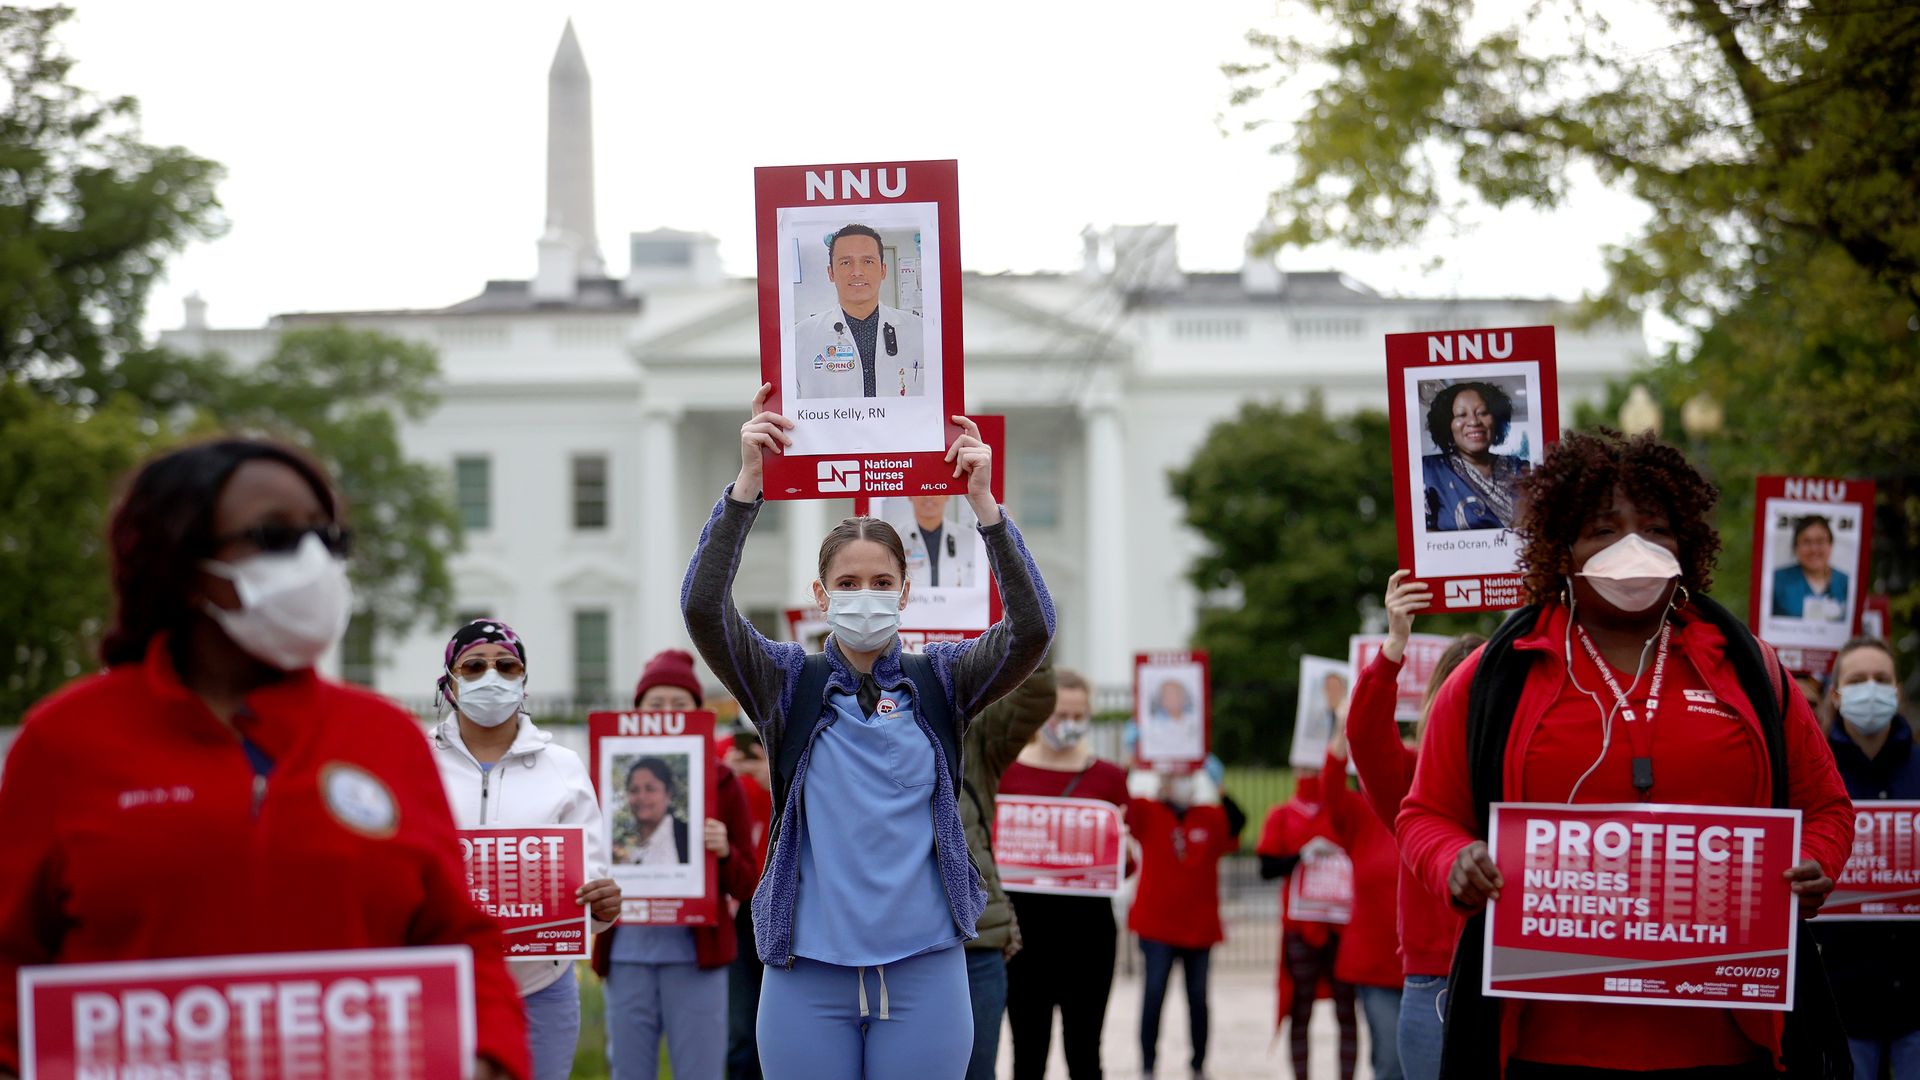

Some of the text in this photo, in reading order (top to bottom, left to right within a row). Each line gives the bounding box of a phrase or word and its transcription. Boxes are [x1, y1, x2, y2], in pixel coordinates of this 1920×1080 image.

[805, 167, 907, 200] NNU
[1427, 332, 1513, 362] NNU
[797, 407, 885, 421] Kious Kelly, RN
[864, 458, 913, 469] National
[865, 471, 904, 480] Nurses
[865, 481, 904, 491] United
[1784, 478, 1847, 502] NNU
[1427, 537, 1508, 551] Freda Ocran, RN
[1484, 576, 1524, 588] National
[1484, 587, 1518, 597] Nurses
[1484, 596, 1517, 607] United
[618, 713, 686, 735] NNU
[998, 803, 1109, 828] PROTECT
[1525, 818, 1766, 863] PROTECT
[458, 836, 565, 862] OTECT
[1846, 855, 1888, 869] ENTS
[1523, 869, 1629, 892] NURSES
[1841, 870, 1920, 884] LIC HEALT
[483, 903, 544, 917] EALTH
[1522, 893, 1650, 917] PATIENTS
[536, 930, 581, 939] #COVID19
[1521, 916, 1727, 944] PUBLIC HEALTH
[1715, 965, 1780, 979] #COVID19
[72, 977, 422, 1050] PROTECT
